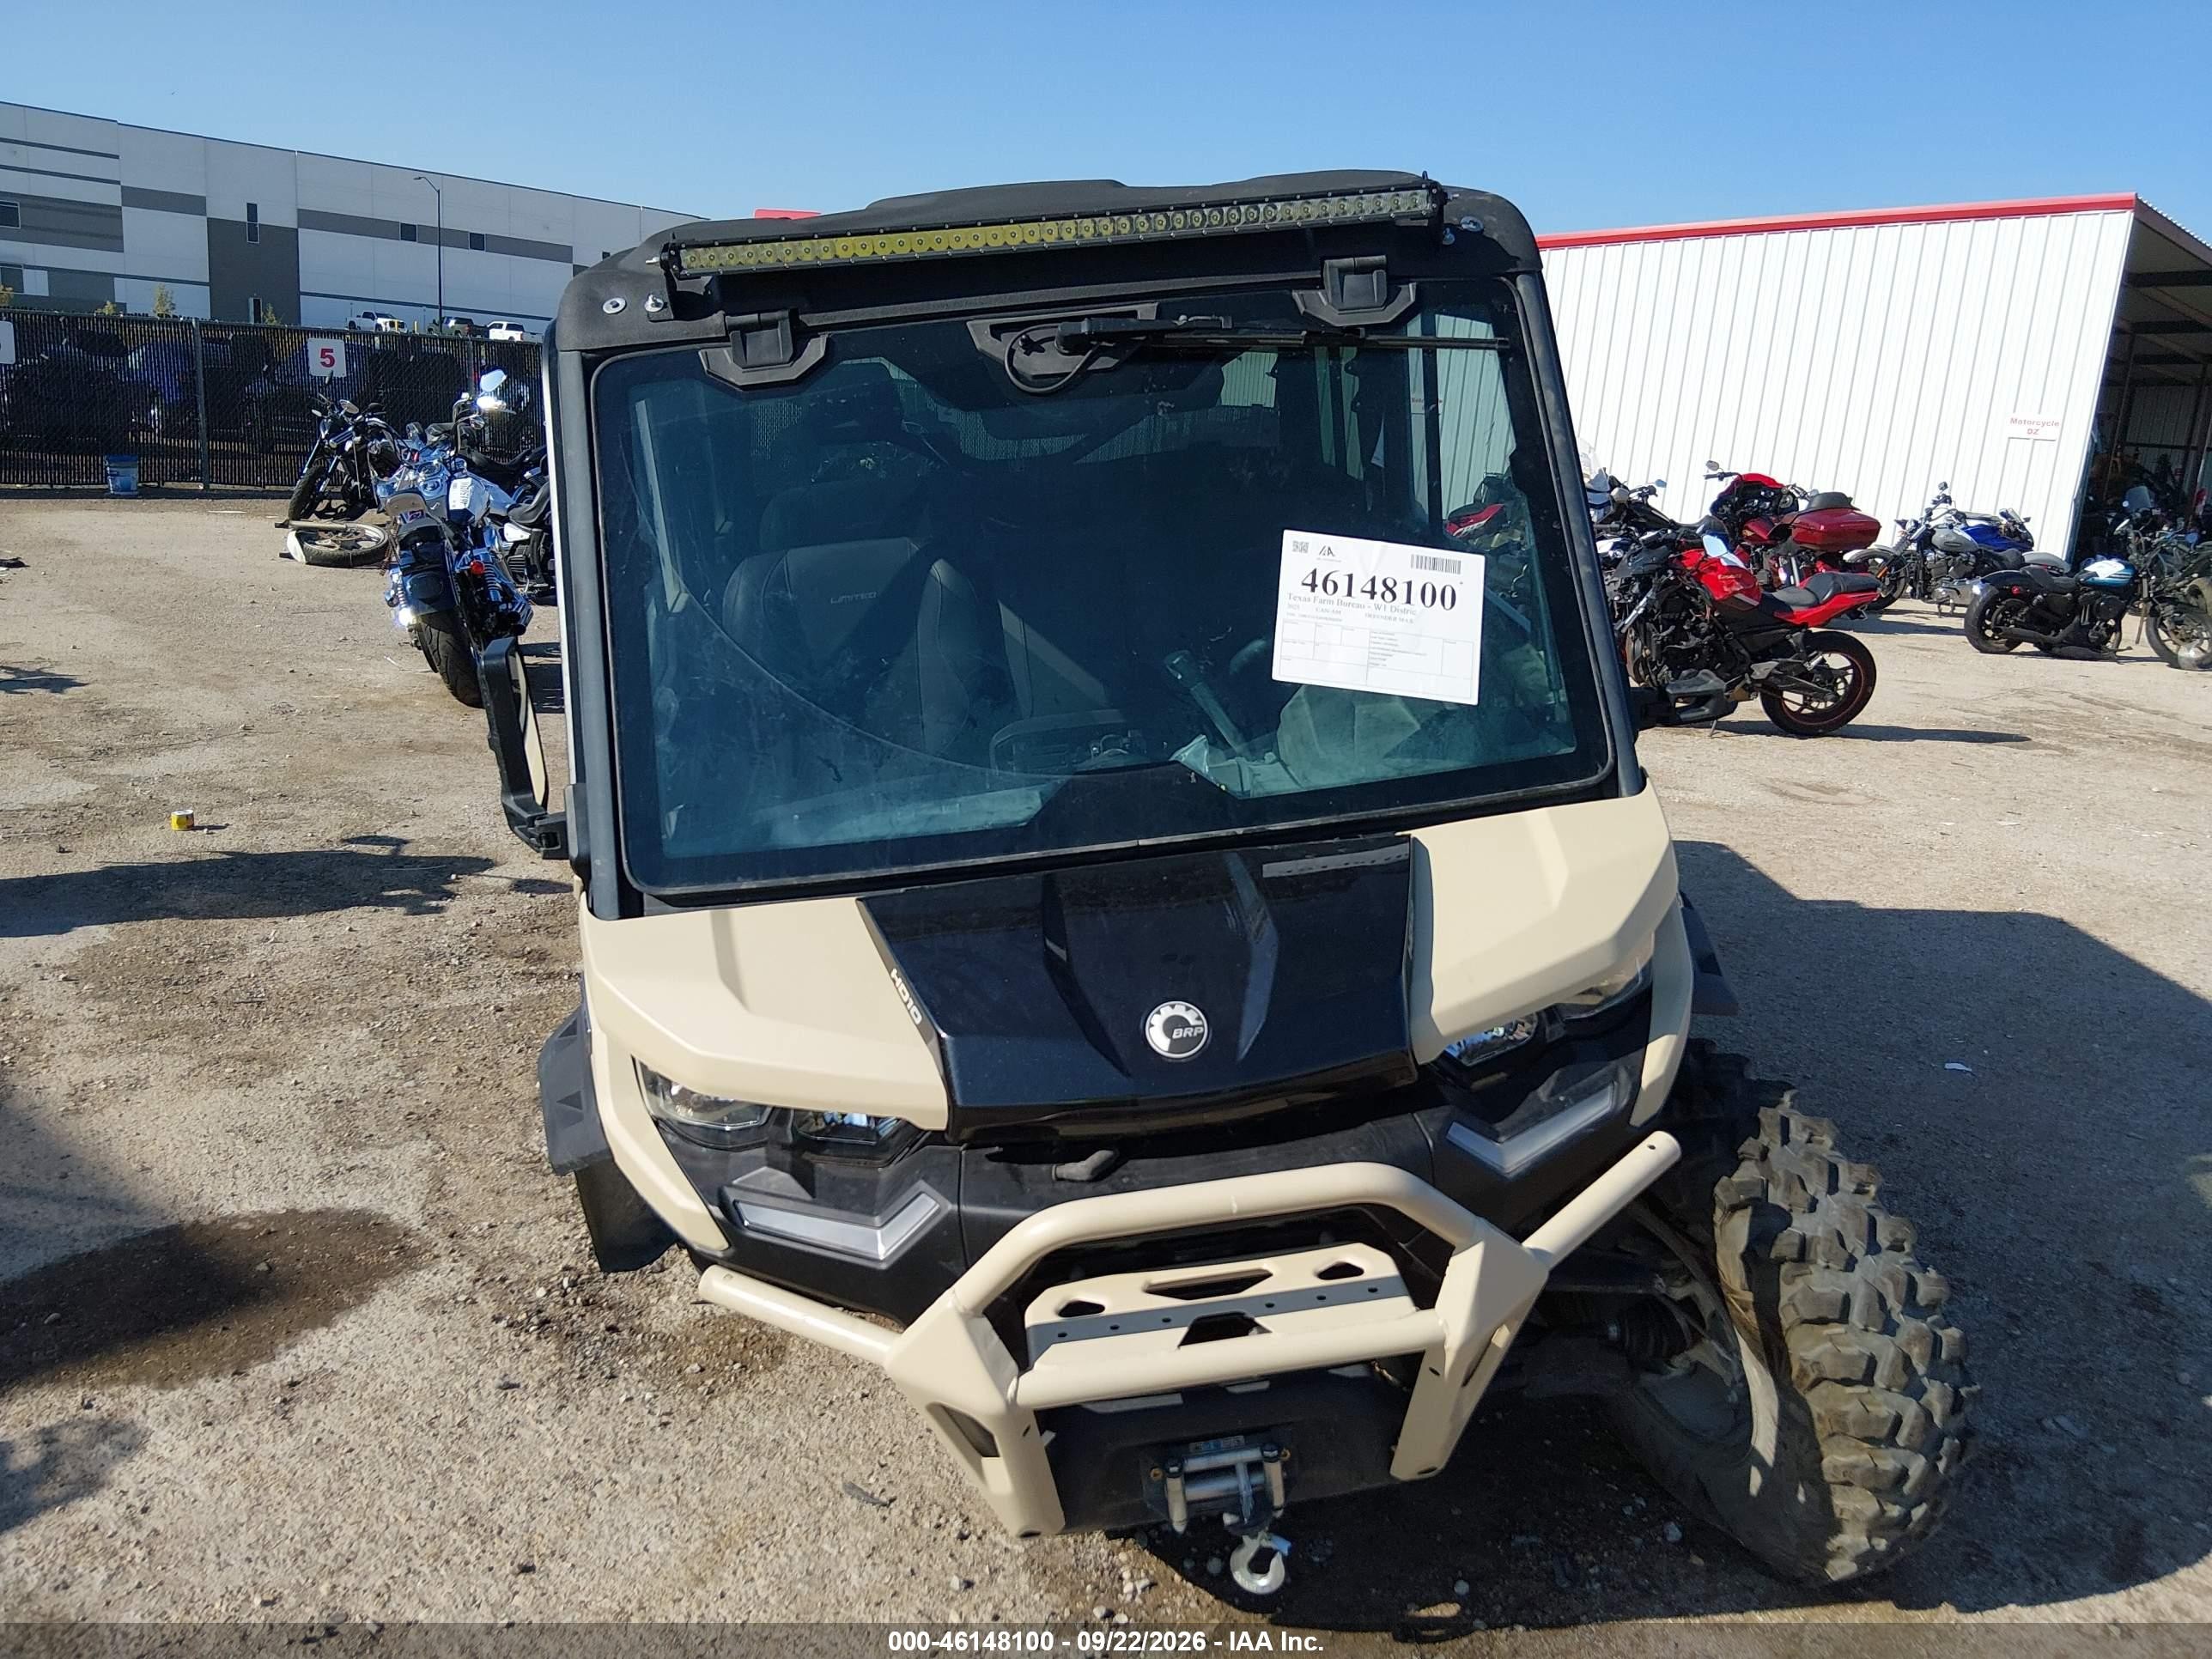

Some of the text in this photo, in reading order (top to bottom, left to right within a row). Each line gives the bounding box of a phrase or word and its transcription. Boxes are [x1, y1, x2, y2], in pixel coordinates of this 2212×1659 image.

[320, 348, 335, 368] 5
[2010, 417, 2060, 428] Motorcycle
[1301, 567, 1457, 611] 46148100
[1287, 592, 1311, 603] Texas
[1313, 596, 1334, 605] Farm
[1336, 598, 1365, 609] Bureau
[1389, 605, 1417, 616] Distric
[890, 968, 922, 1024] HD10
[1172, 1026, 1204, 1039] BRP
